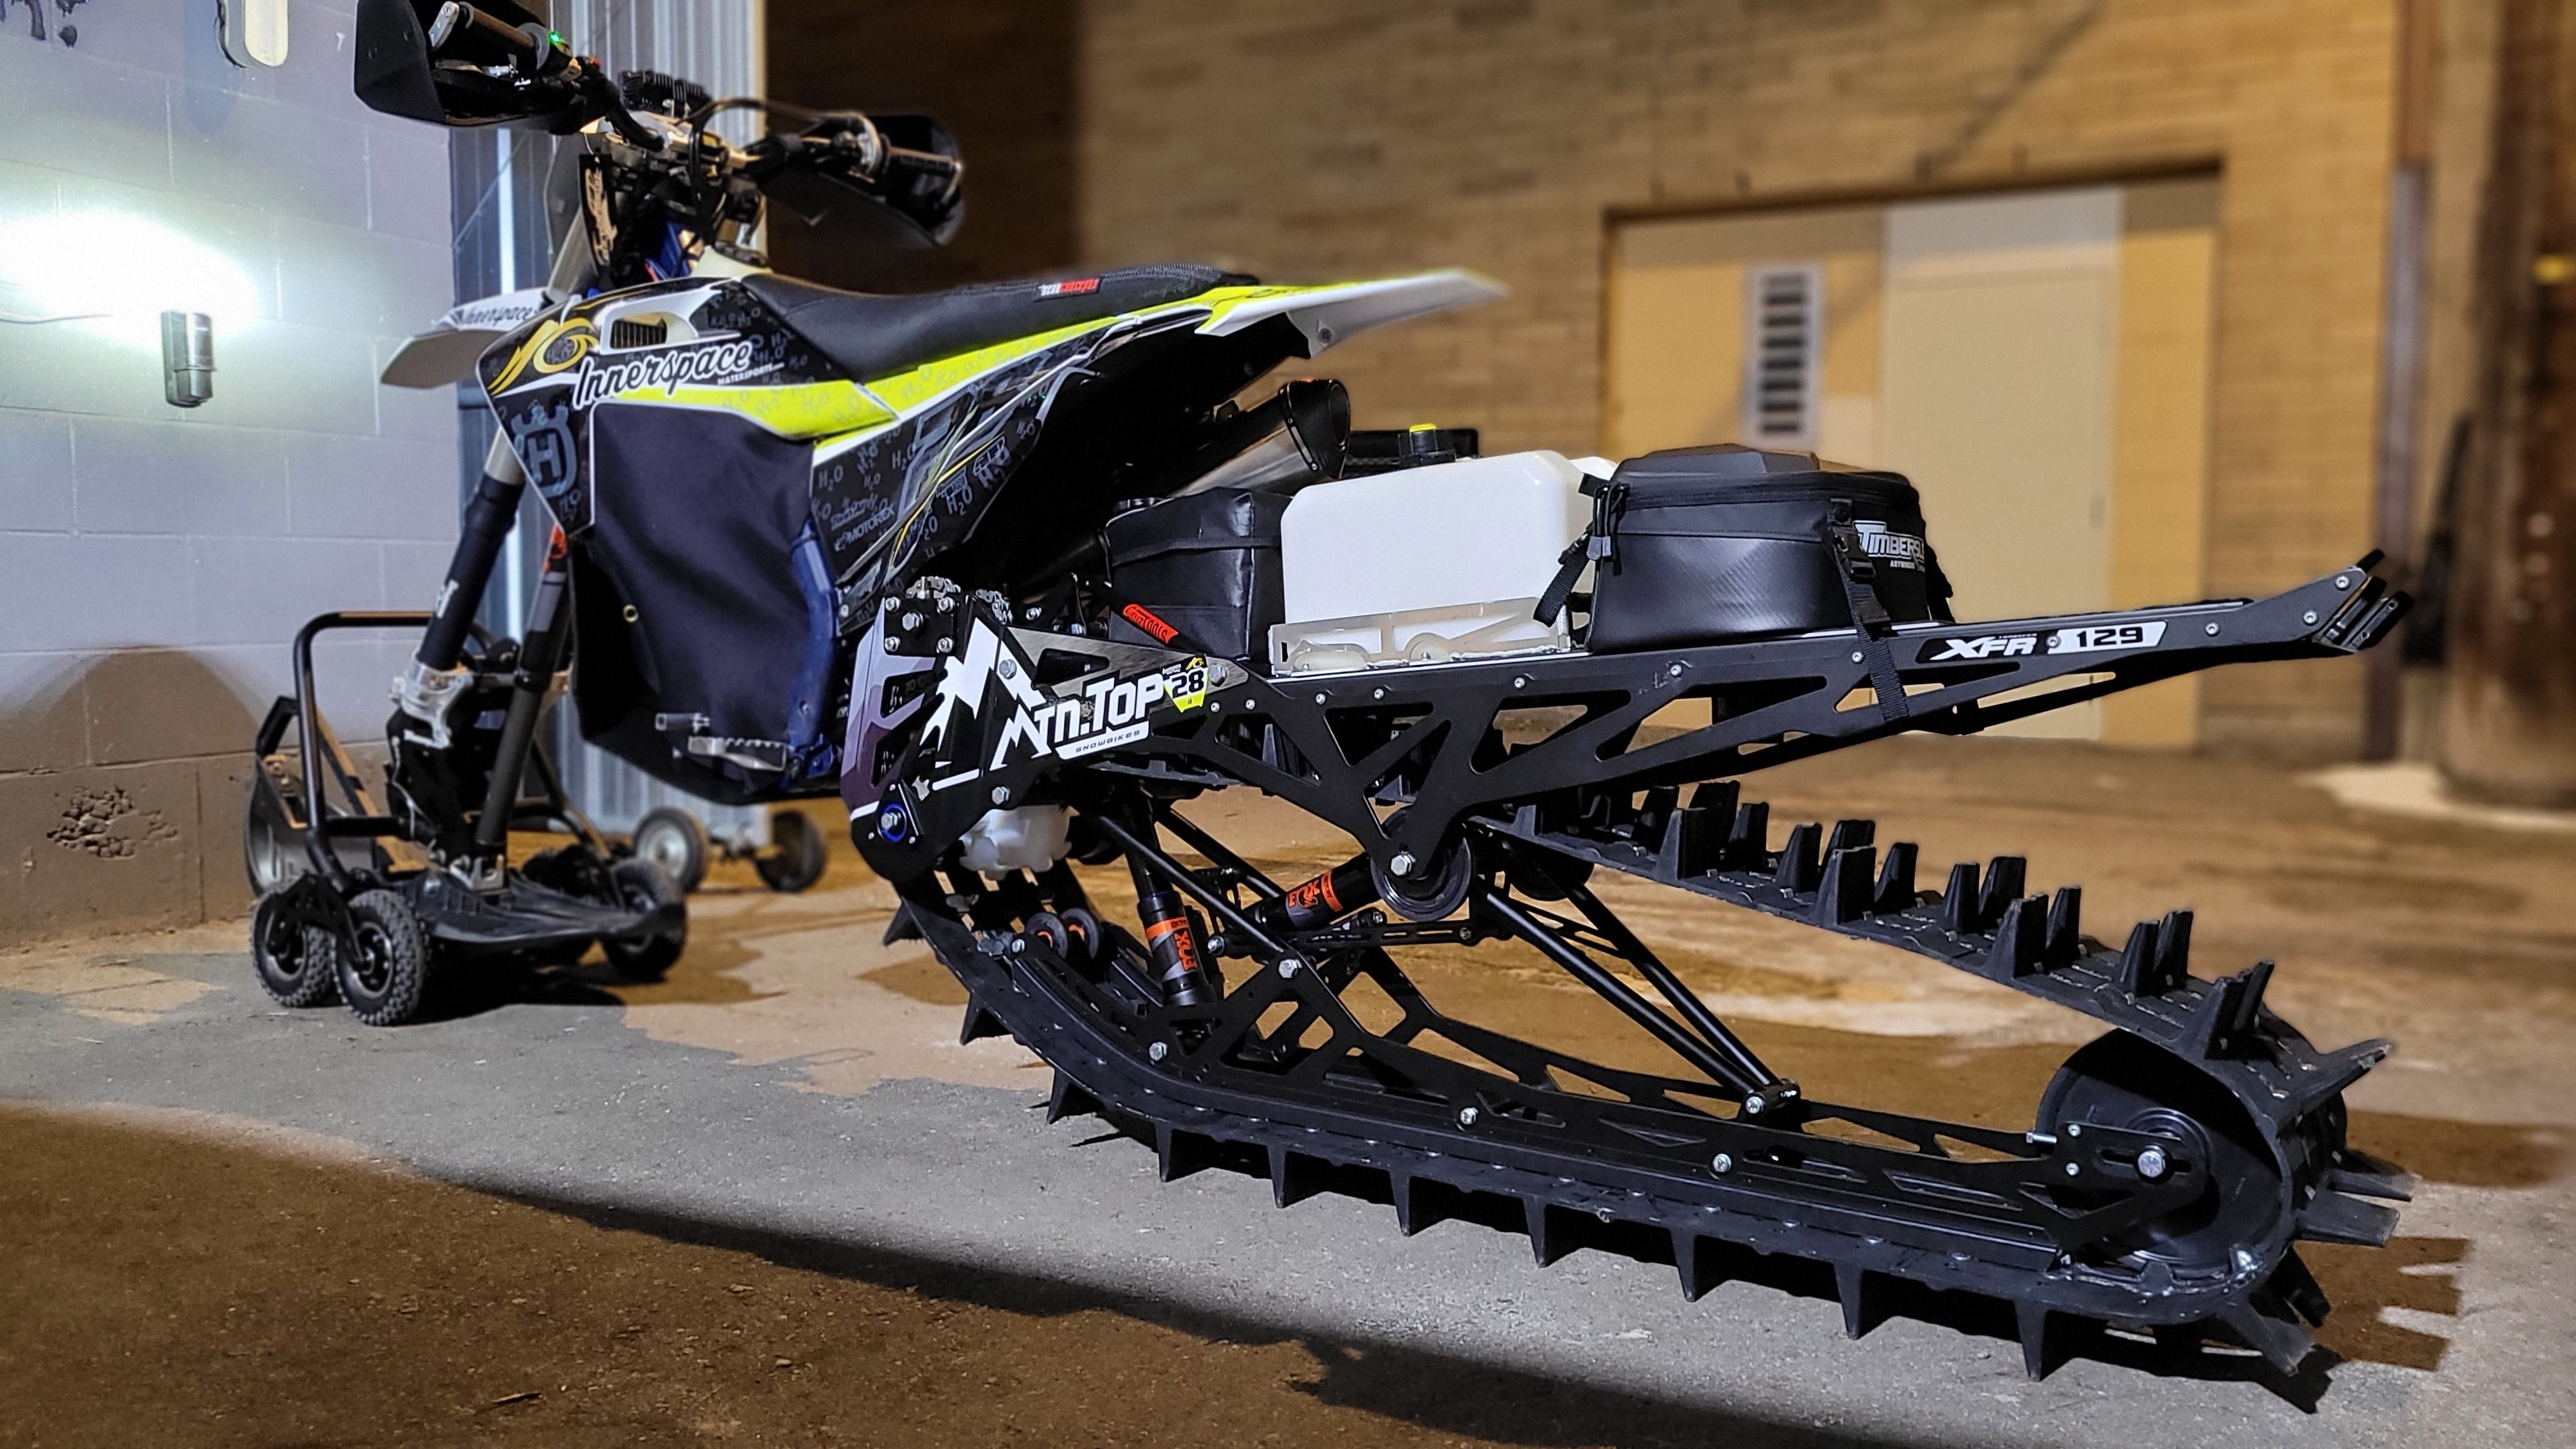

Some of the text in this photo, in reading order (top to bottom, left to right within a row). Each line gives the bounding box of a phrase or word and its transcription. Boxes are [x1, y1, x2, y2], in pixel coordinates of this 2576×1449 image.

[573, 342, 753, 410] Innerspace
[847, 503, 894, 544] MOTOREX
[1929, 635, 2037, 661] XFR
[2076, 626, 2143, 648] 129
[1171, 670, 1204, 698] 28
[1075, 729, 1140, 753] SNOWBIKES
[1288, 879, 1321, 908] FOX
[1174, 930, 1199, 970] FOX
